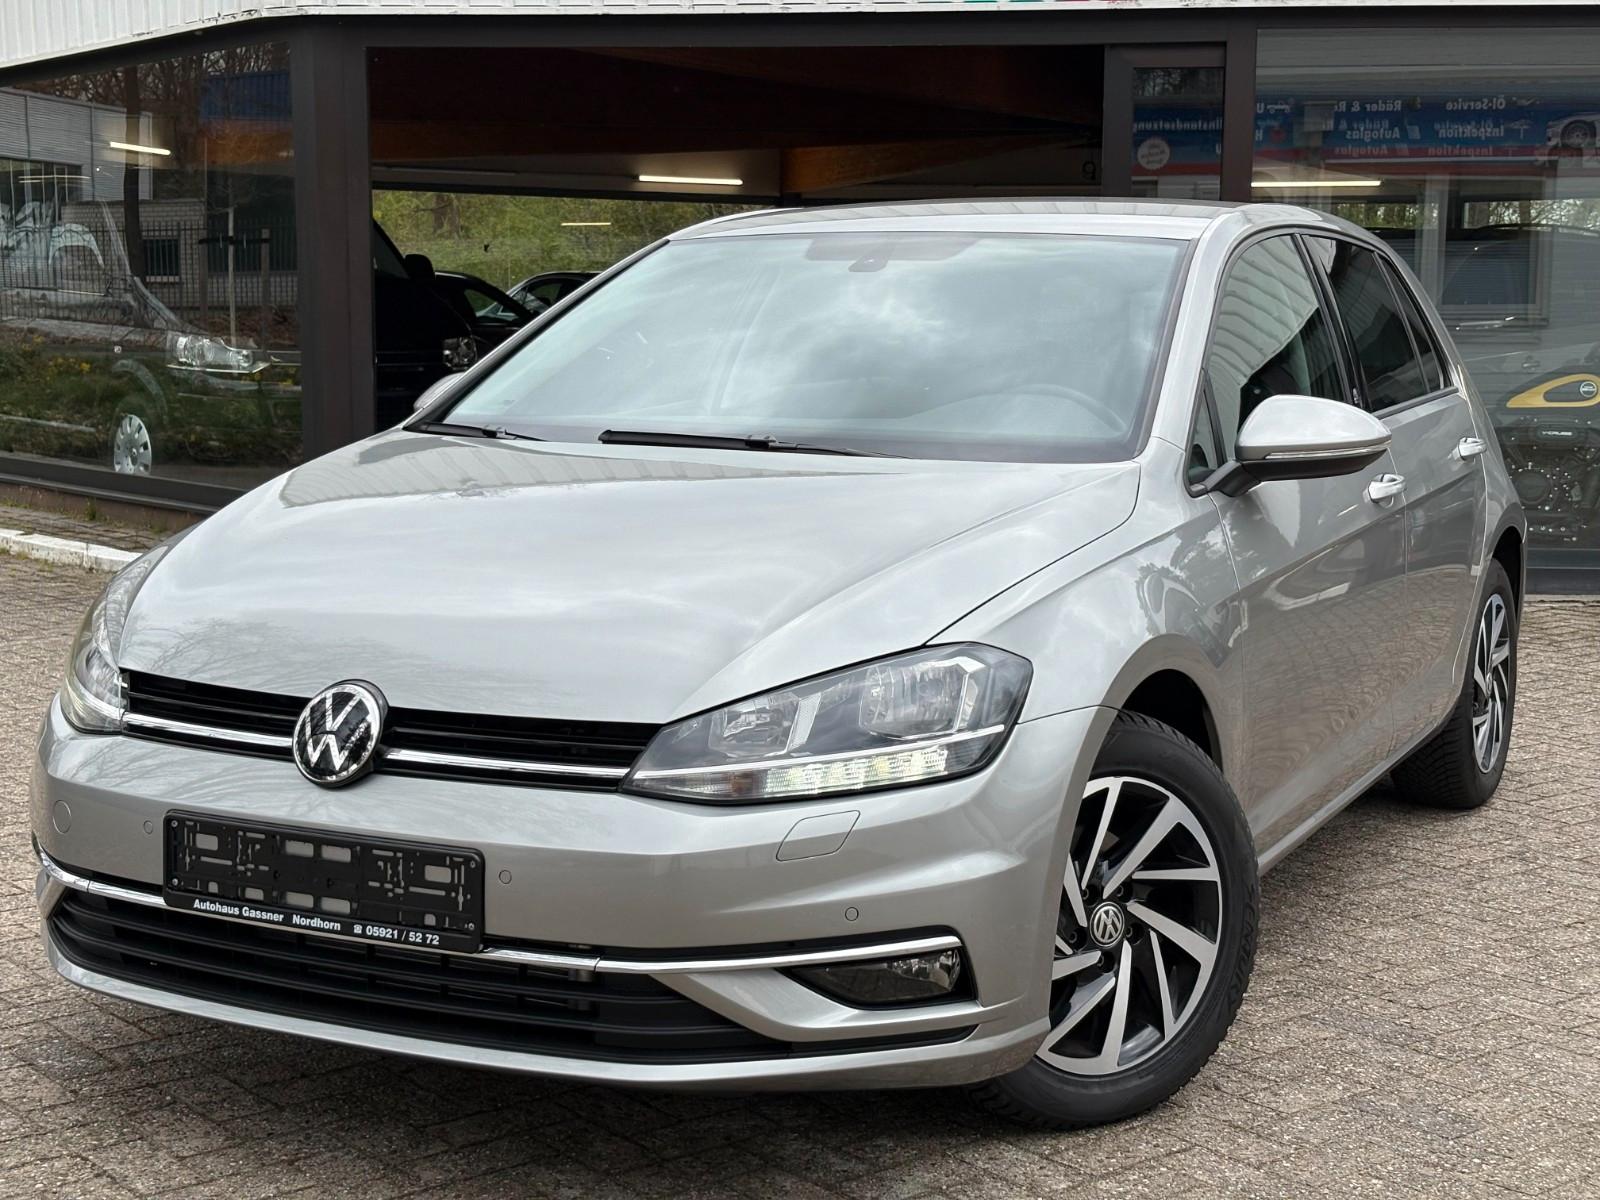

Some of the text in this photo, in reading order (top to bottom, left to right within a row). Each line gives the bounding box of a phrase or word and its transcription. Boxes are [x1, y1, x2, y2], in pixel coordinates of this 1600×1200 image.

[193, 898, 240, 915] Autohaus
[242, 906, 284, 922] Gassner
[292, 914, 341, 931] Nordhorn
[365, 925, 399, 940] 05921
[408, 931, 422, 943] 52
[425, 934, 440, 945] 72
